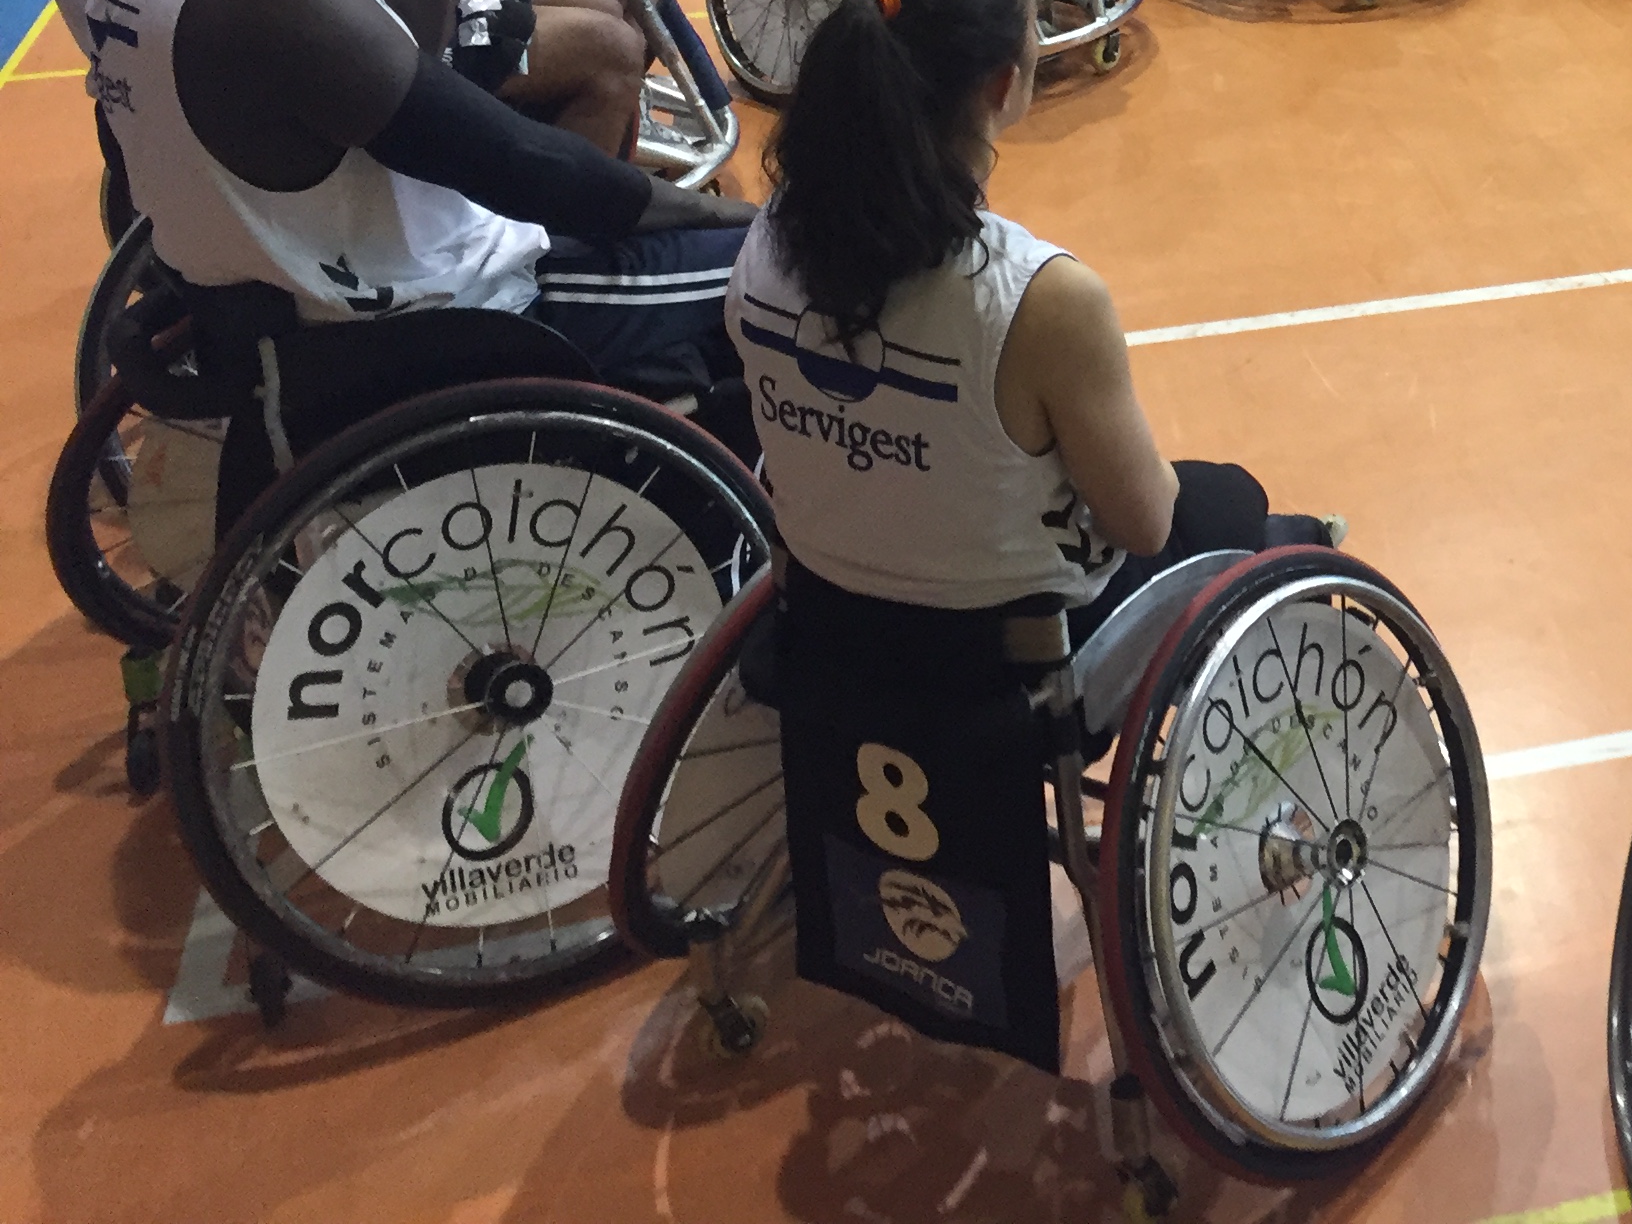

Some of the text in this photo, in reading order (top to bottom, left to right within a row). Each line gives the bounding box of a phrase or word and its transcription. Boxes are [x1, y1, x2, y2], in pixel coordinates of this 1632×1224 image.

[758, 374, 931, 473] Servigest
[286, 478, 696, 721] norcolchón
[856, 743, 940, 862] 8
[1169, 622, 1398, 1002] norcolchón
[421, 842, 576, 900] villaverde
[1333, 954, 1410, 1078] villaverde
